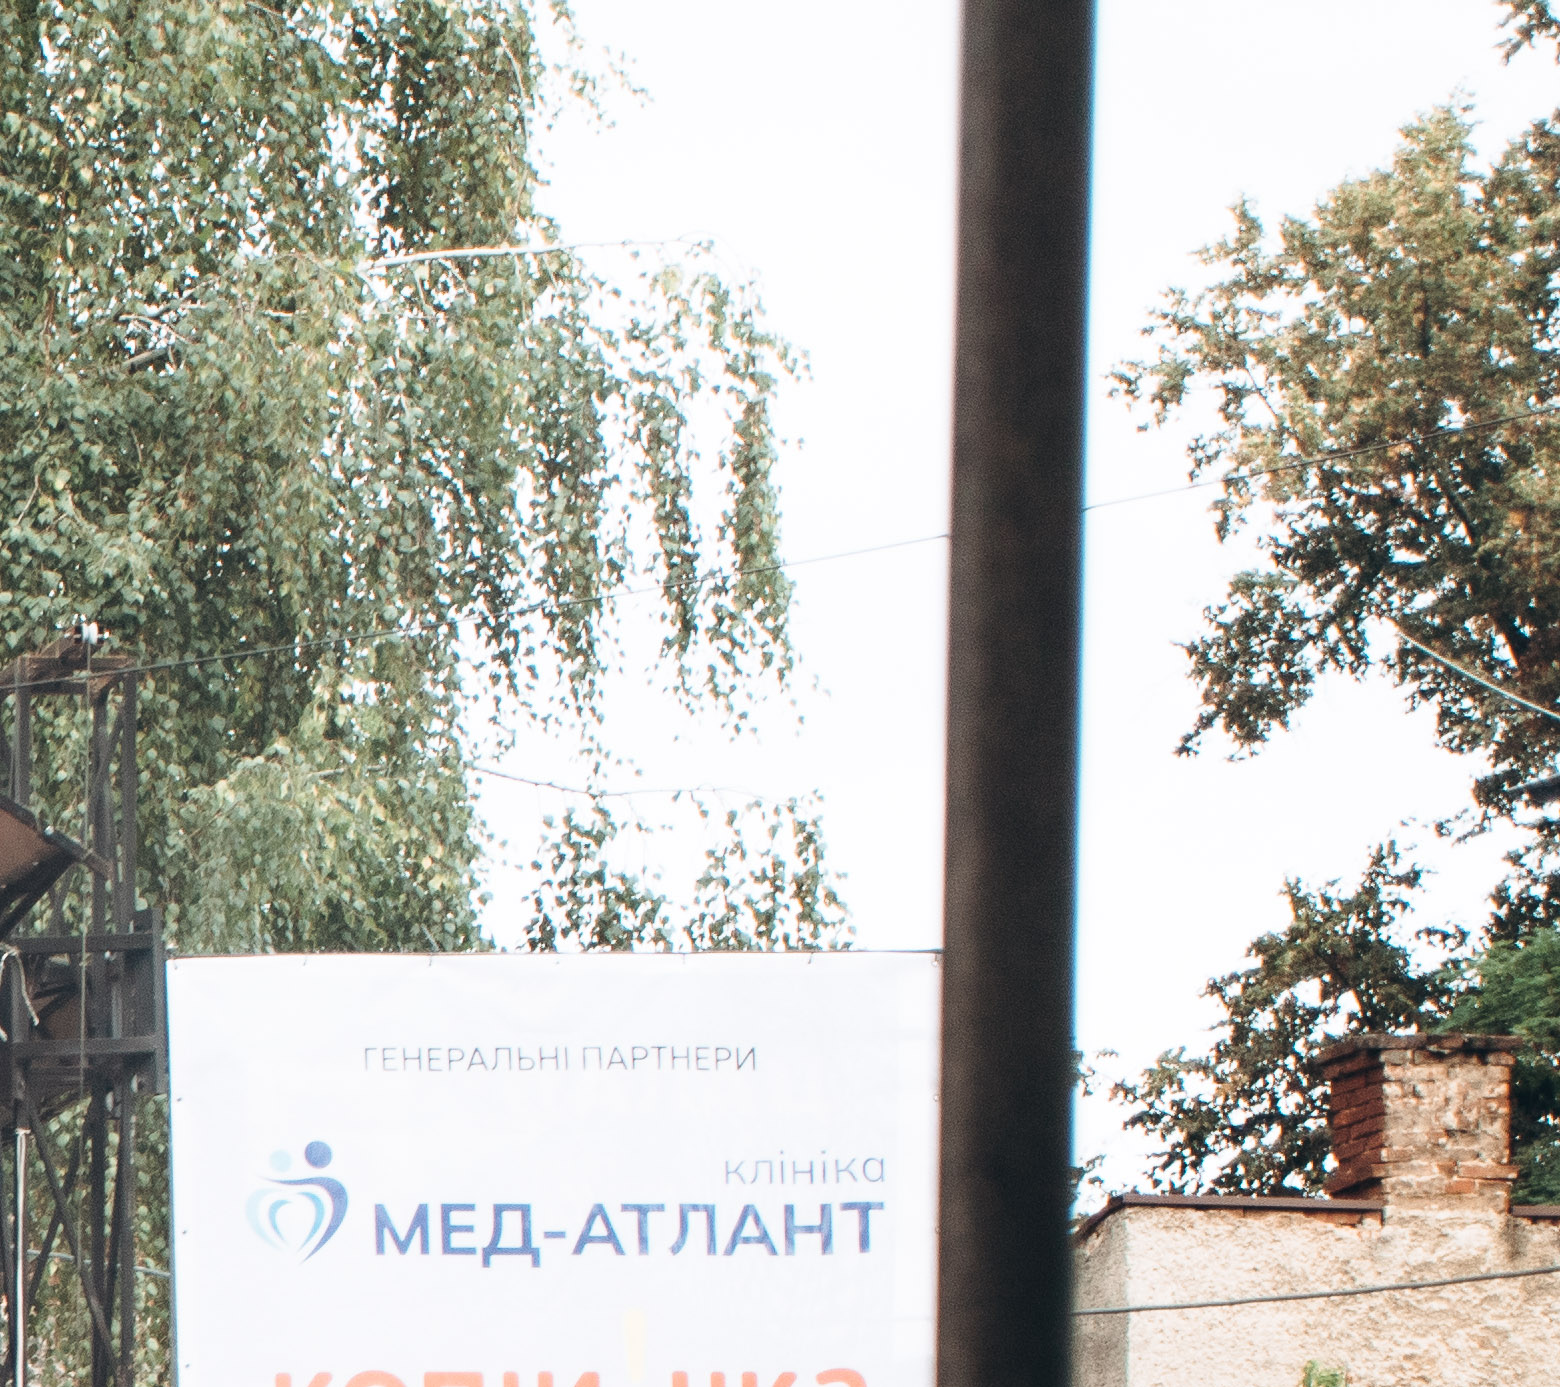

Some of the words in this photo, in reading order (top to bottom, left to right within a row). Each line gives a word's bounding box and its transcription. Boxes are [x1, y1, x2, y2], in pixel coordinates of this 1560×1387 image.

[363, 1044, 570, 1073] ГЕНЕРАЛЬНІ
[581, 1044, 758, 1072] ПАРТНЕРИ
[724, 1150, 887, 1186] клініка
[374, 1200, 885, 1268] МЕД-АТЛАНТ
